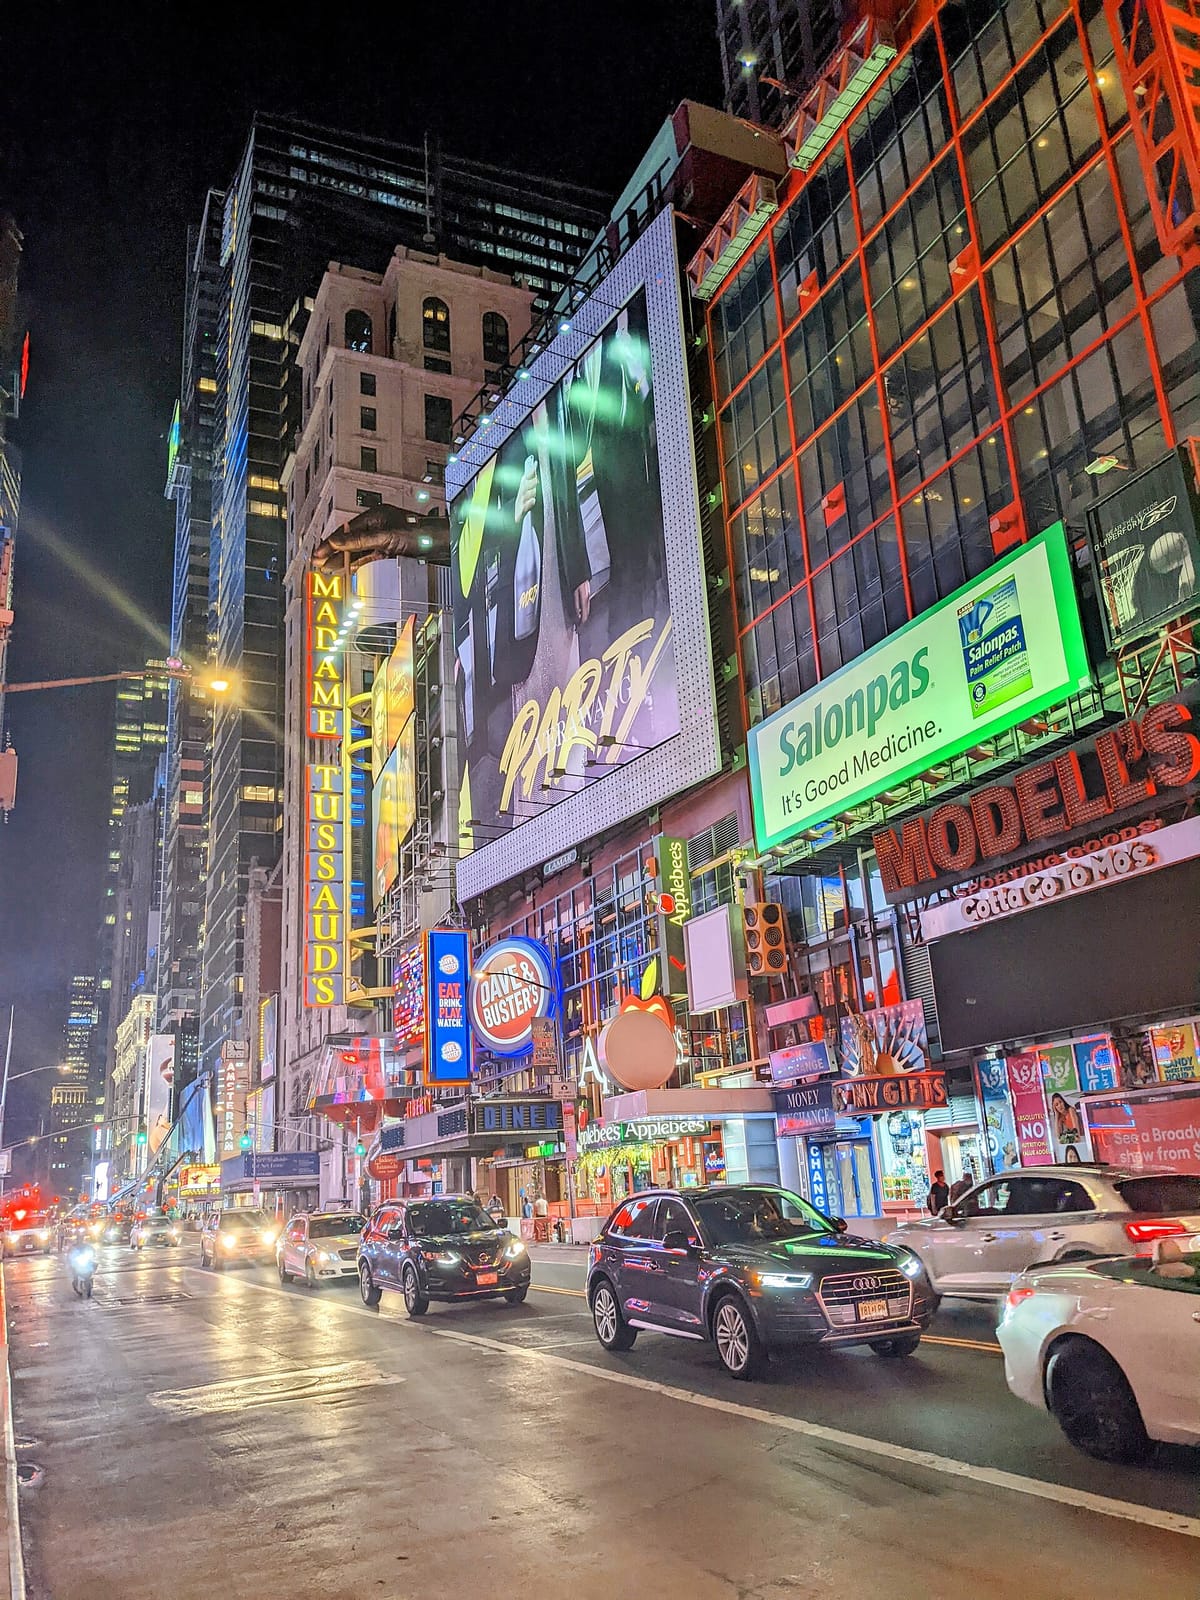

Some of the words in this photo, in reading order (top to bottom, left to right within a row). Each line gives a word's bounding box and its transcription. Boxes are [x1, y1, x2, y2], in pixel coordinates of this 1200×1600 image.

[312, 573, 341, 735] MADAME
[969, 625, 1018, 665] Salonpas
[970, 663, 984, 678] Pain
[984, 651, 1003, 670] Relief
[1004, 640, 1022, 658] Patch
[498, 615, 673, 812] PARTY
[779, 646, 930, 777] Salonpas
[782, 790, 802, 816] It's
[804, 761, 849, 802] Good
[853, 720, 943, 778] Medicine.
[872, 703, 1200, 894] MODELL'S
[953, 854, 1065, 900] SPORTING
[1066, 819, 1163, 860] GOODS
[1058, 863, 1088, 892] To
[1088, 842, 1155, 882] Mo's
[312, 765, 341, 1005] TUSSAUD'S
[669, 842, 690, 927] Applebee's
[438, 983, 462, 998] EAT.
[439, 998, 462, 1008] DRINK.
[481, 963, 522, 1008] DAVE
[520, 961, 535, 982] &
[483, 984, 539, 1029] BUSTER'S
[439, 1007, 462, 1018] PLAY.
[223, 1061, 235, 1152] AMSTERDAM
[786, 1089, 820, 1109] MONEY
[852, 1082, 878, 1108] NY
[882, 1075, 947, 1105] GIFTS
[483, 1103, 558, 1130] DINER
[624, 1120, 705, 1140] Applebee's
[1021, 1121, 1044, 1140] NO
[1114, 1130, 1139, 1145] See
[1141, 1131, 1150, 1143] a
[1120, 1148, 1155, 1164] show
[1156, 1146, 1191, 1161] from
[810, 1146, 826, 1212] CHANG
